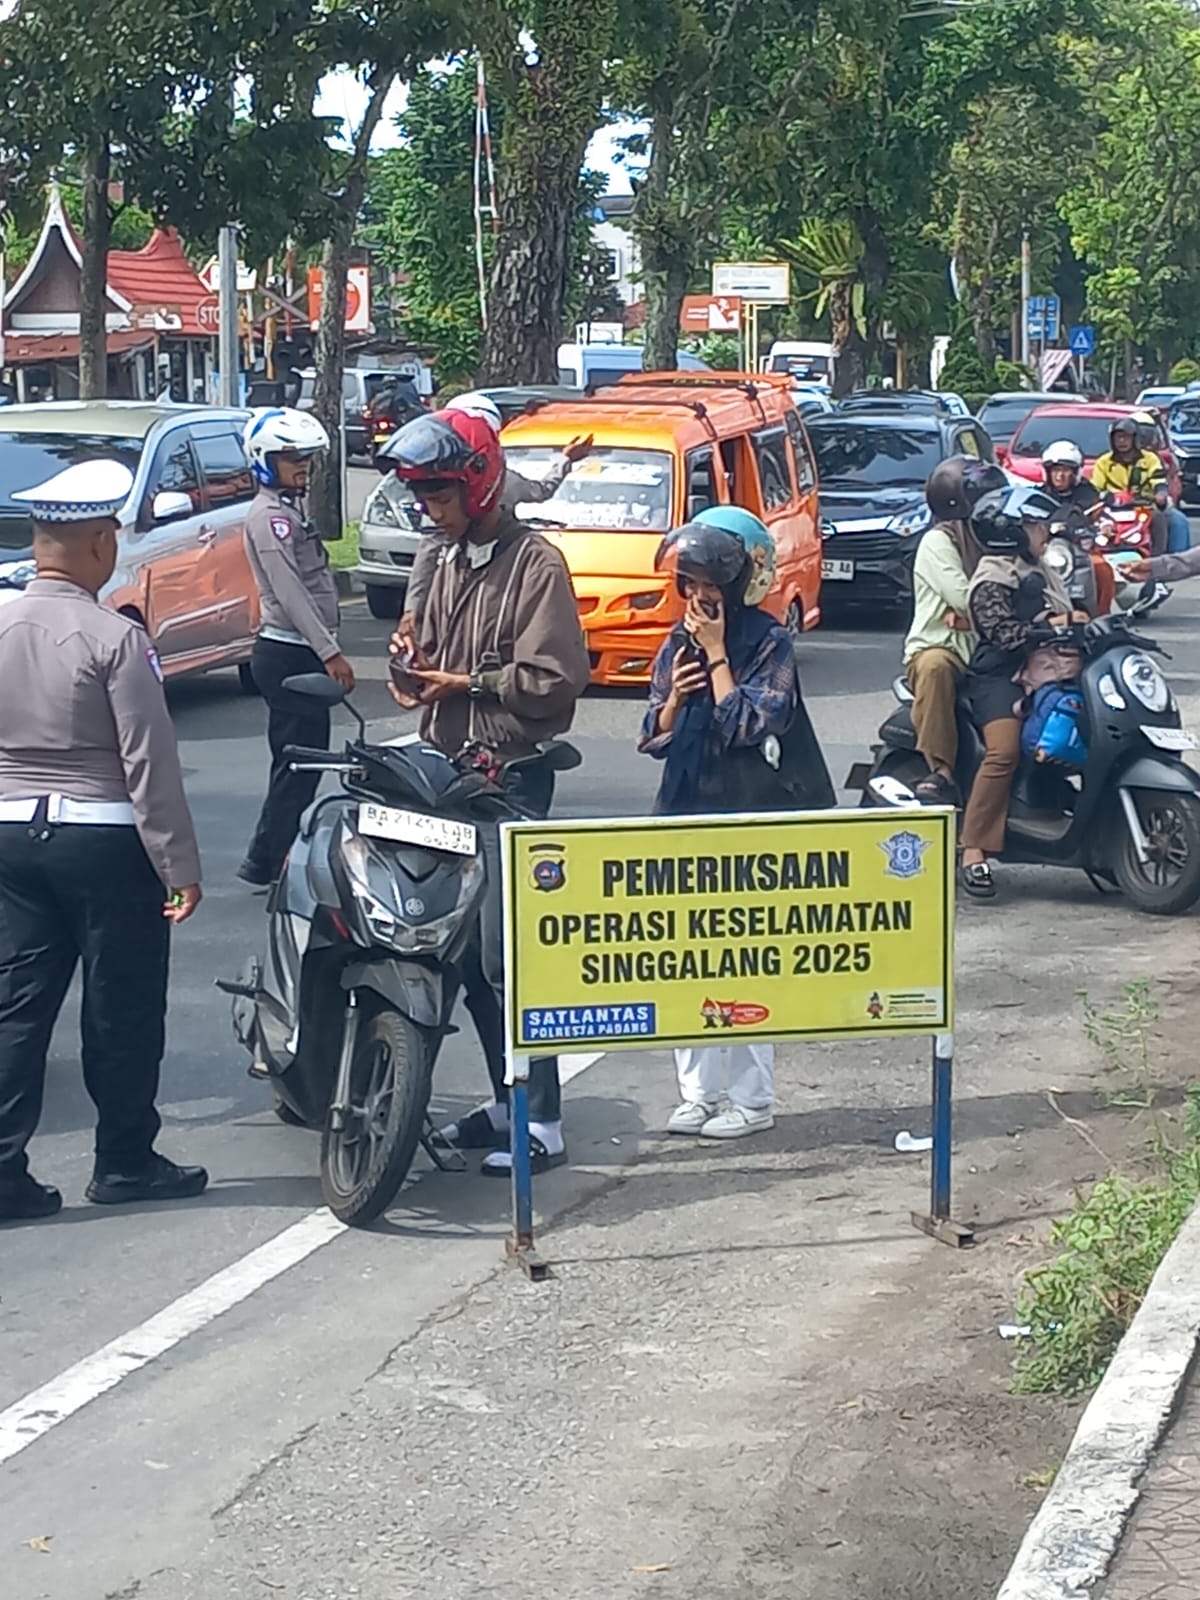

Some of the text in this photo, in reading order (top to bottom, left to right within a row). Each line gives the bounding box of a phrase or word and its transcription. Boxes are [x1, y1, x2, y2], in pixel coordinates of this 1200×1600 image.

[200, 306, 220, 325] STO
[602, 850, 850, 898] PEMERIKSAAN
[538, 900, 912, 946] OPERASI KESELAMATAN
[581, 942, 872, 985] SINGGALANG 2025
[529, 1006, 648, 1026] SATLANTAS
[530, 1022, 648, 1039] POLRESTA PADANG
